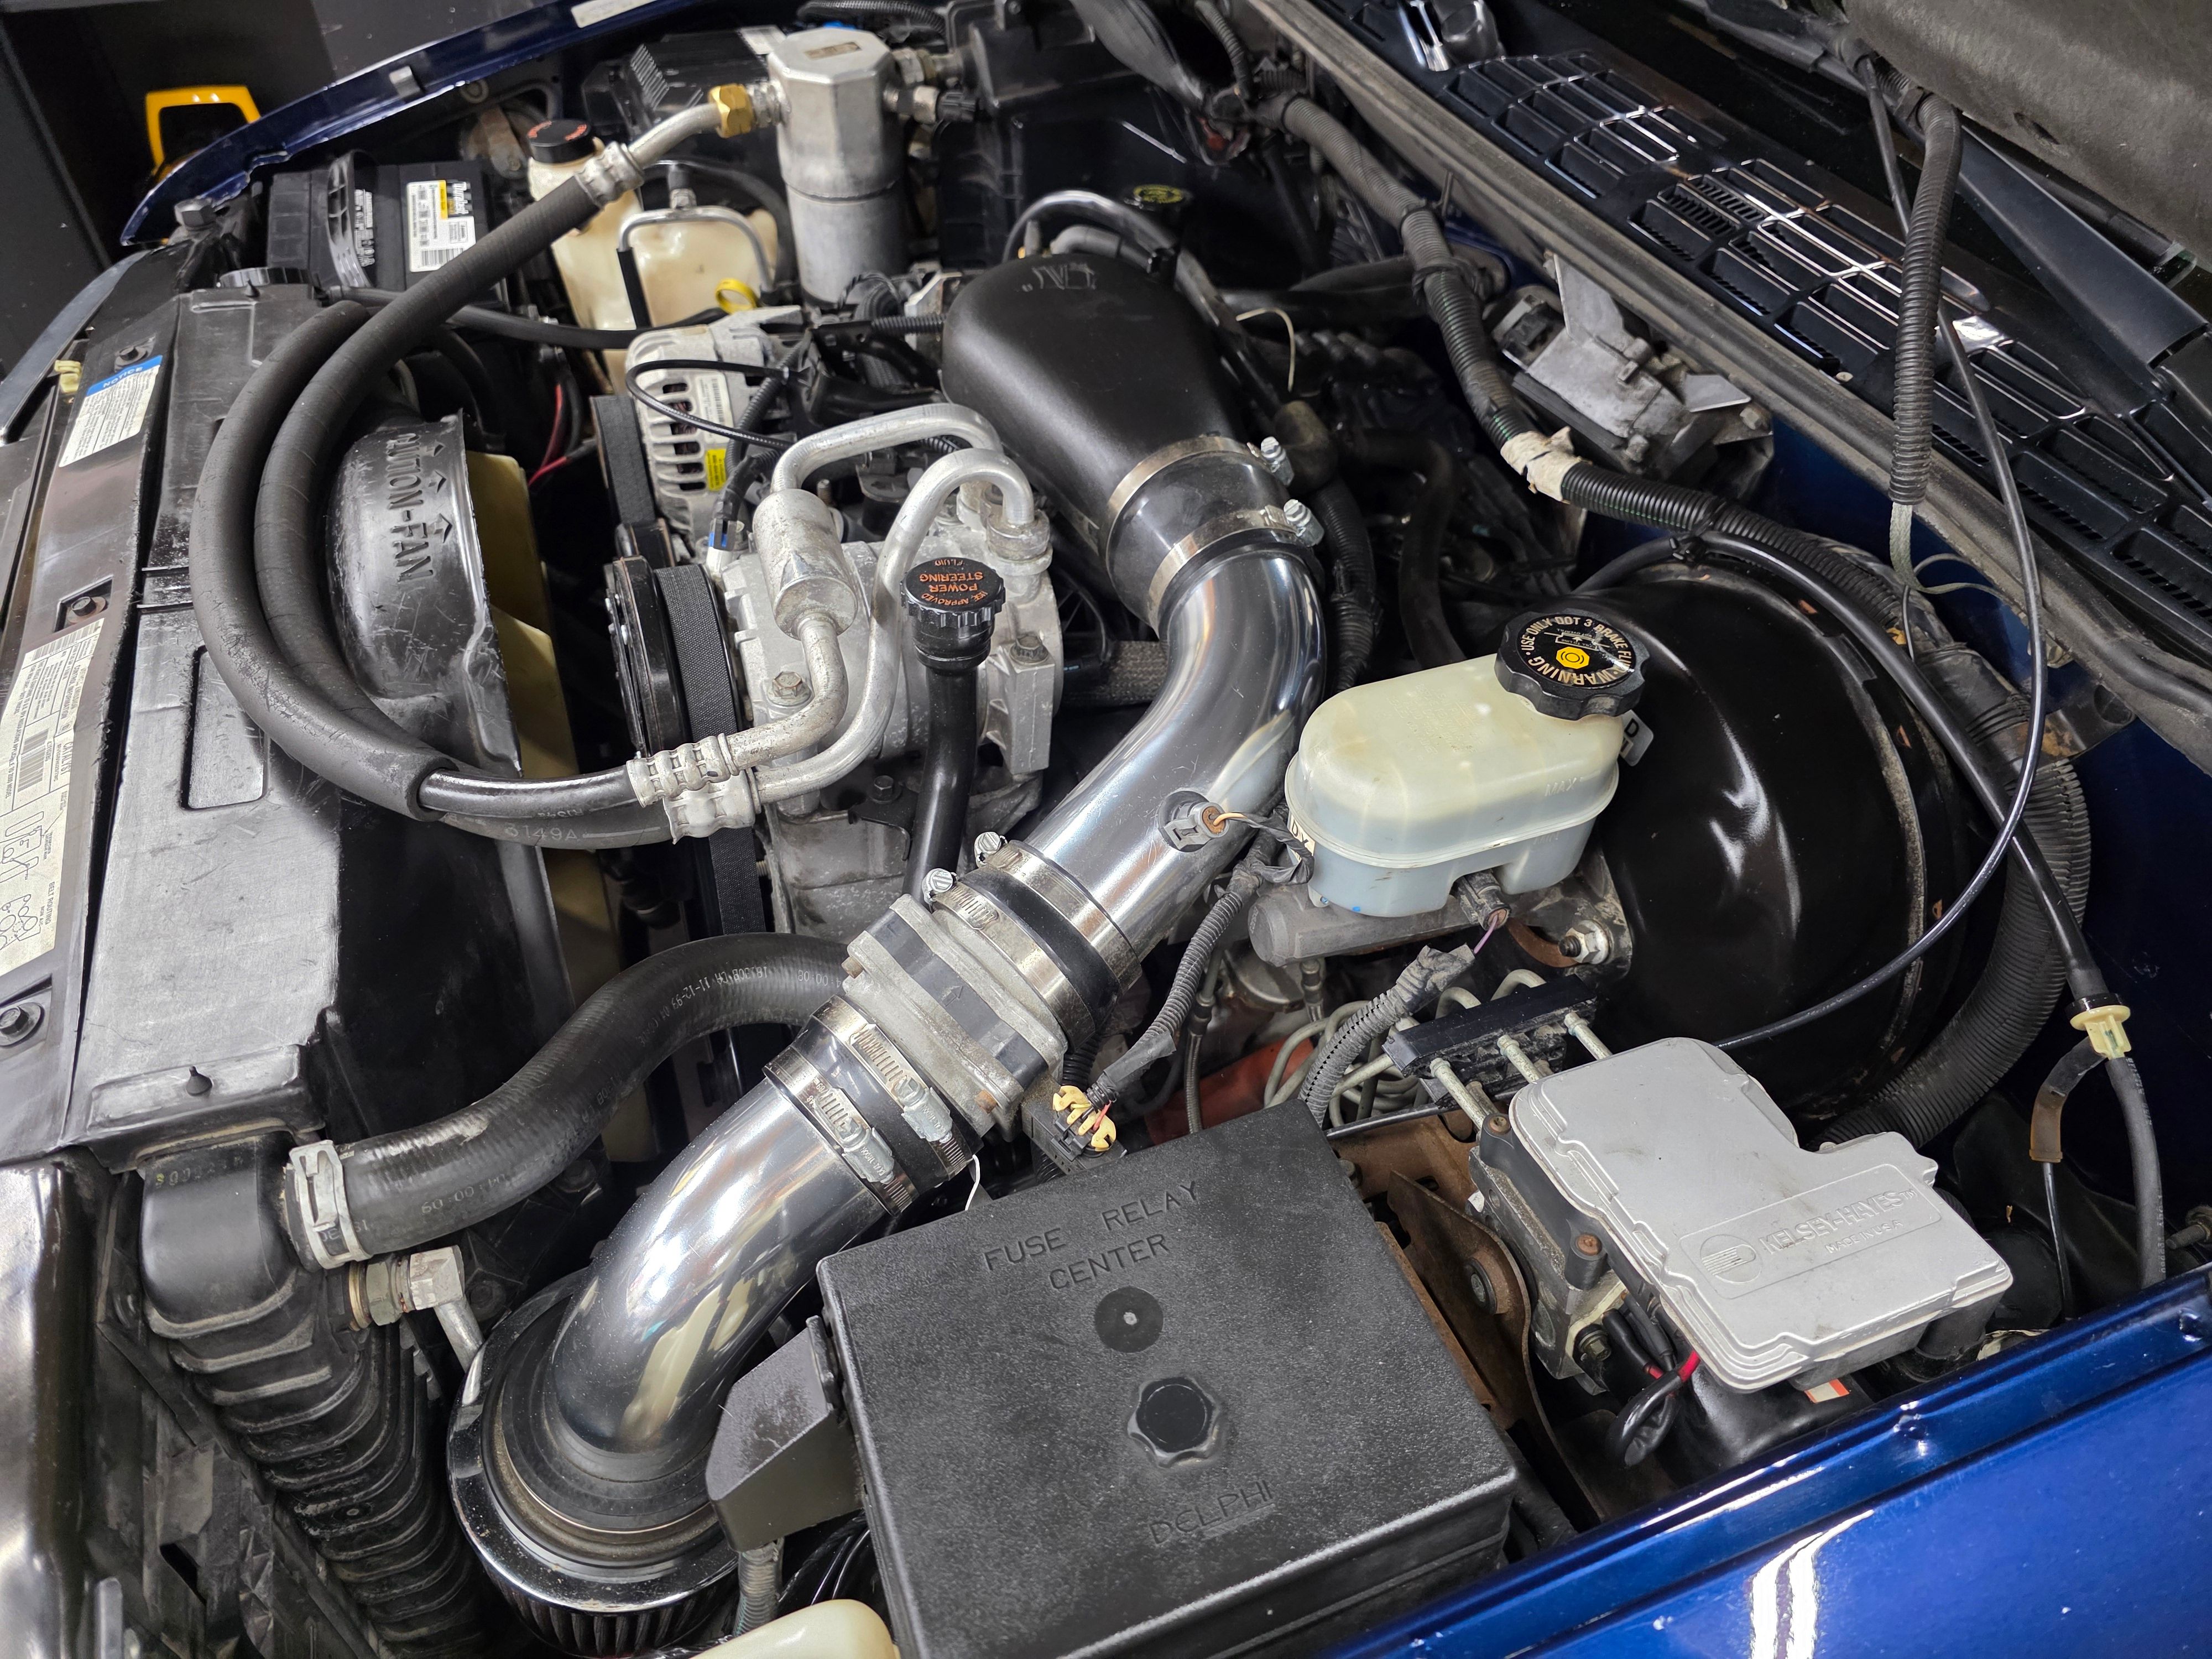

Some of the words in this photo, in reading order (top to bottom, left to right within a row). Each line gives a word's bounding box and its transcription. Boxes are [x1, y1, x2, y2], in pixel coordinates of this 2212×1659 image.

[103, 367, 143, 388] NOTICE
[919, 571, 984, 582] STEERING
[928, 583, 978, 593] POWER
[971, 591, 988, 602] USE
[921, 593, 969, 606] APPROVED
[1526, 618, 1553, 635] ONLY
[1554, 616, 1581, 625] DOT
[1584, 619, 1593, 627] 3
[1521, 634, 1536, 651] USE
[1593, 624, 1629, 649] BRAKE
[1528, 656, 1617, 686] WARNING
[60, 742, 74, 775] CATALYST
[1544, 776, 1577, 797] MAX
[45, 897, 54, 925] ROUTING
[983, 1227, 1067, 1271] FUSE
[1101, 1180, 1197, 1231] RELAY
[1824, 1234, 1860, 1254] MADE
[1049, 1233, 1170, 1290] CENTER
[1149, 1479, 1273, 1545] DELPHI
